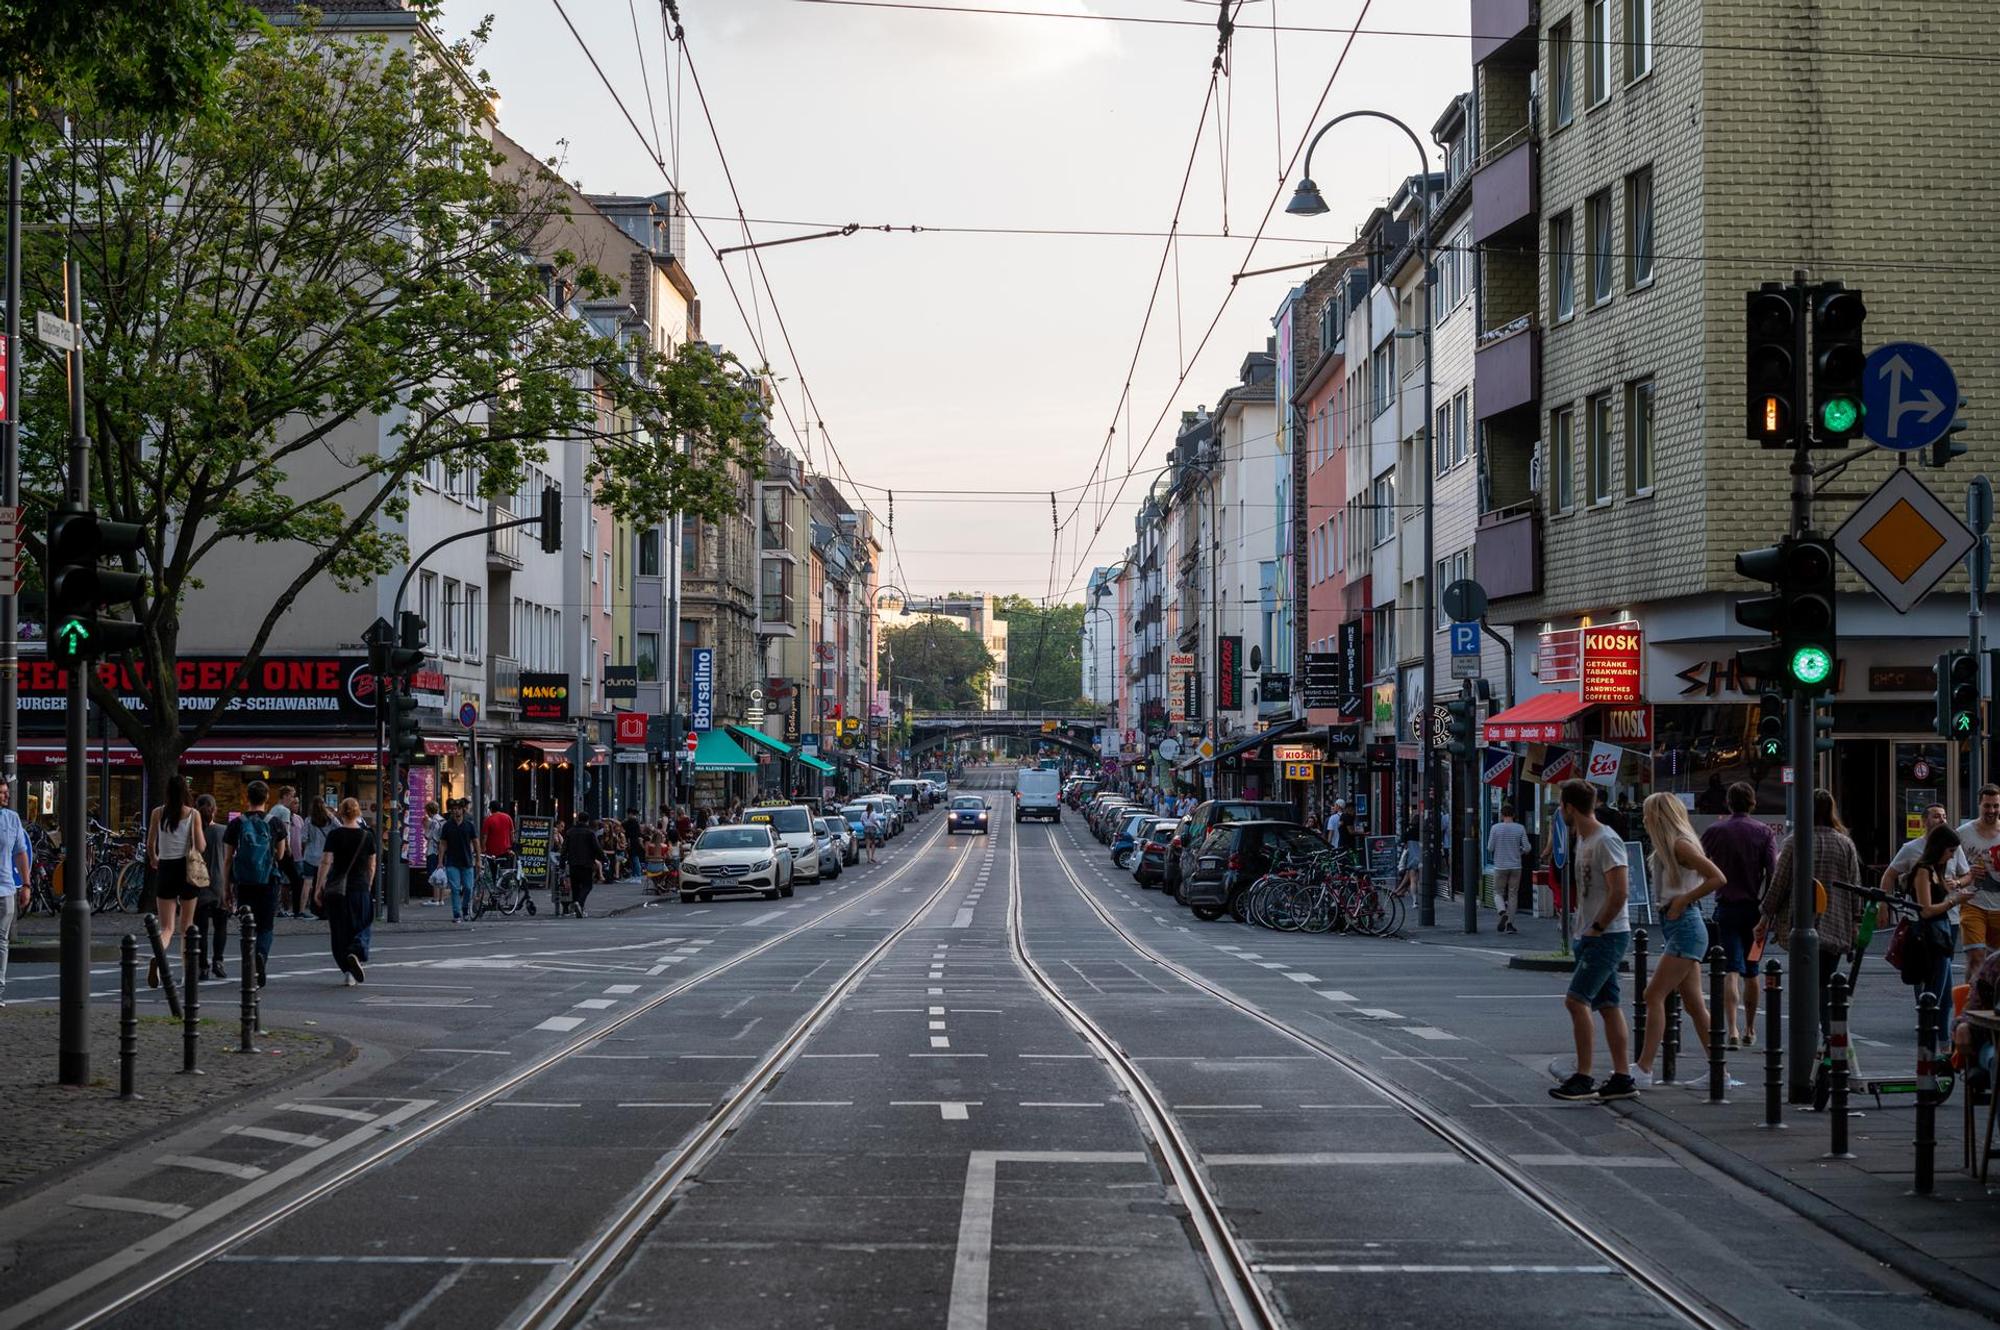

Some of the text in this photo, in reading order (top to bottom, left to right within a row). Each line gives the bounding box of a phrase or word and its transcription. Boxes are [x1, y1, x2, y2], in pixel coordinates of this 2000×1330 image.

[1458, 628, 1472, 651] P
[1585, 635, 1639, 650] KIOSK
[1171, 655, 1193, 664] Falafel
[95, 661, 250, 691] BUGER
[263, 661, 341, 690] ONE
[1586, 668, 1638, 676] TABAKWAREN
[522, 686, 567, 698] MANGO
[693, 652, 710, 729] Borsalino
[178, 696, 341, 711] POMMS-SCHAWARMA
[1609, 709, 1647, 738] KIOSK
[1332, 732, 1355, 746] sky
[1286, 751, 1312, 759] KIOSK
[521, 847, 545, 855] HOUR
